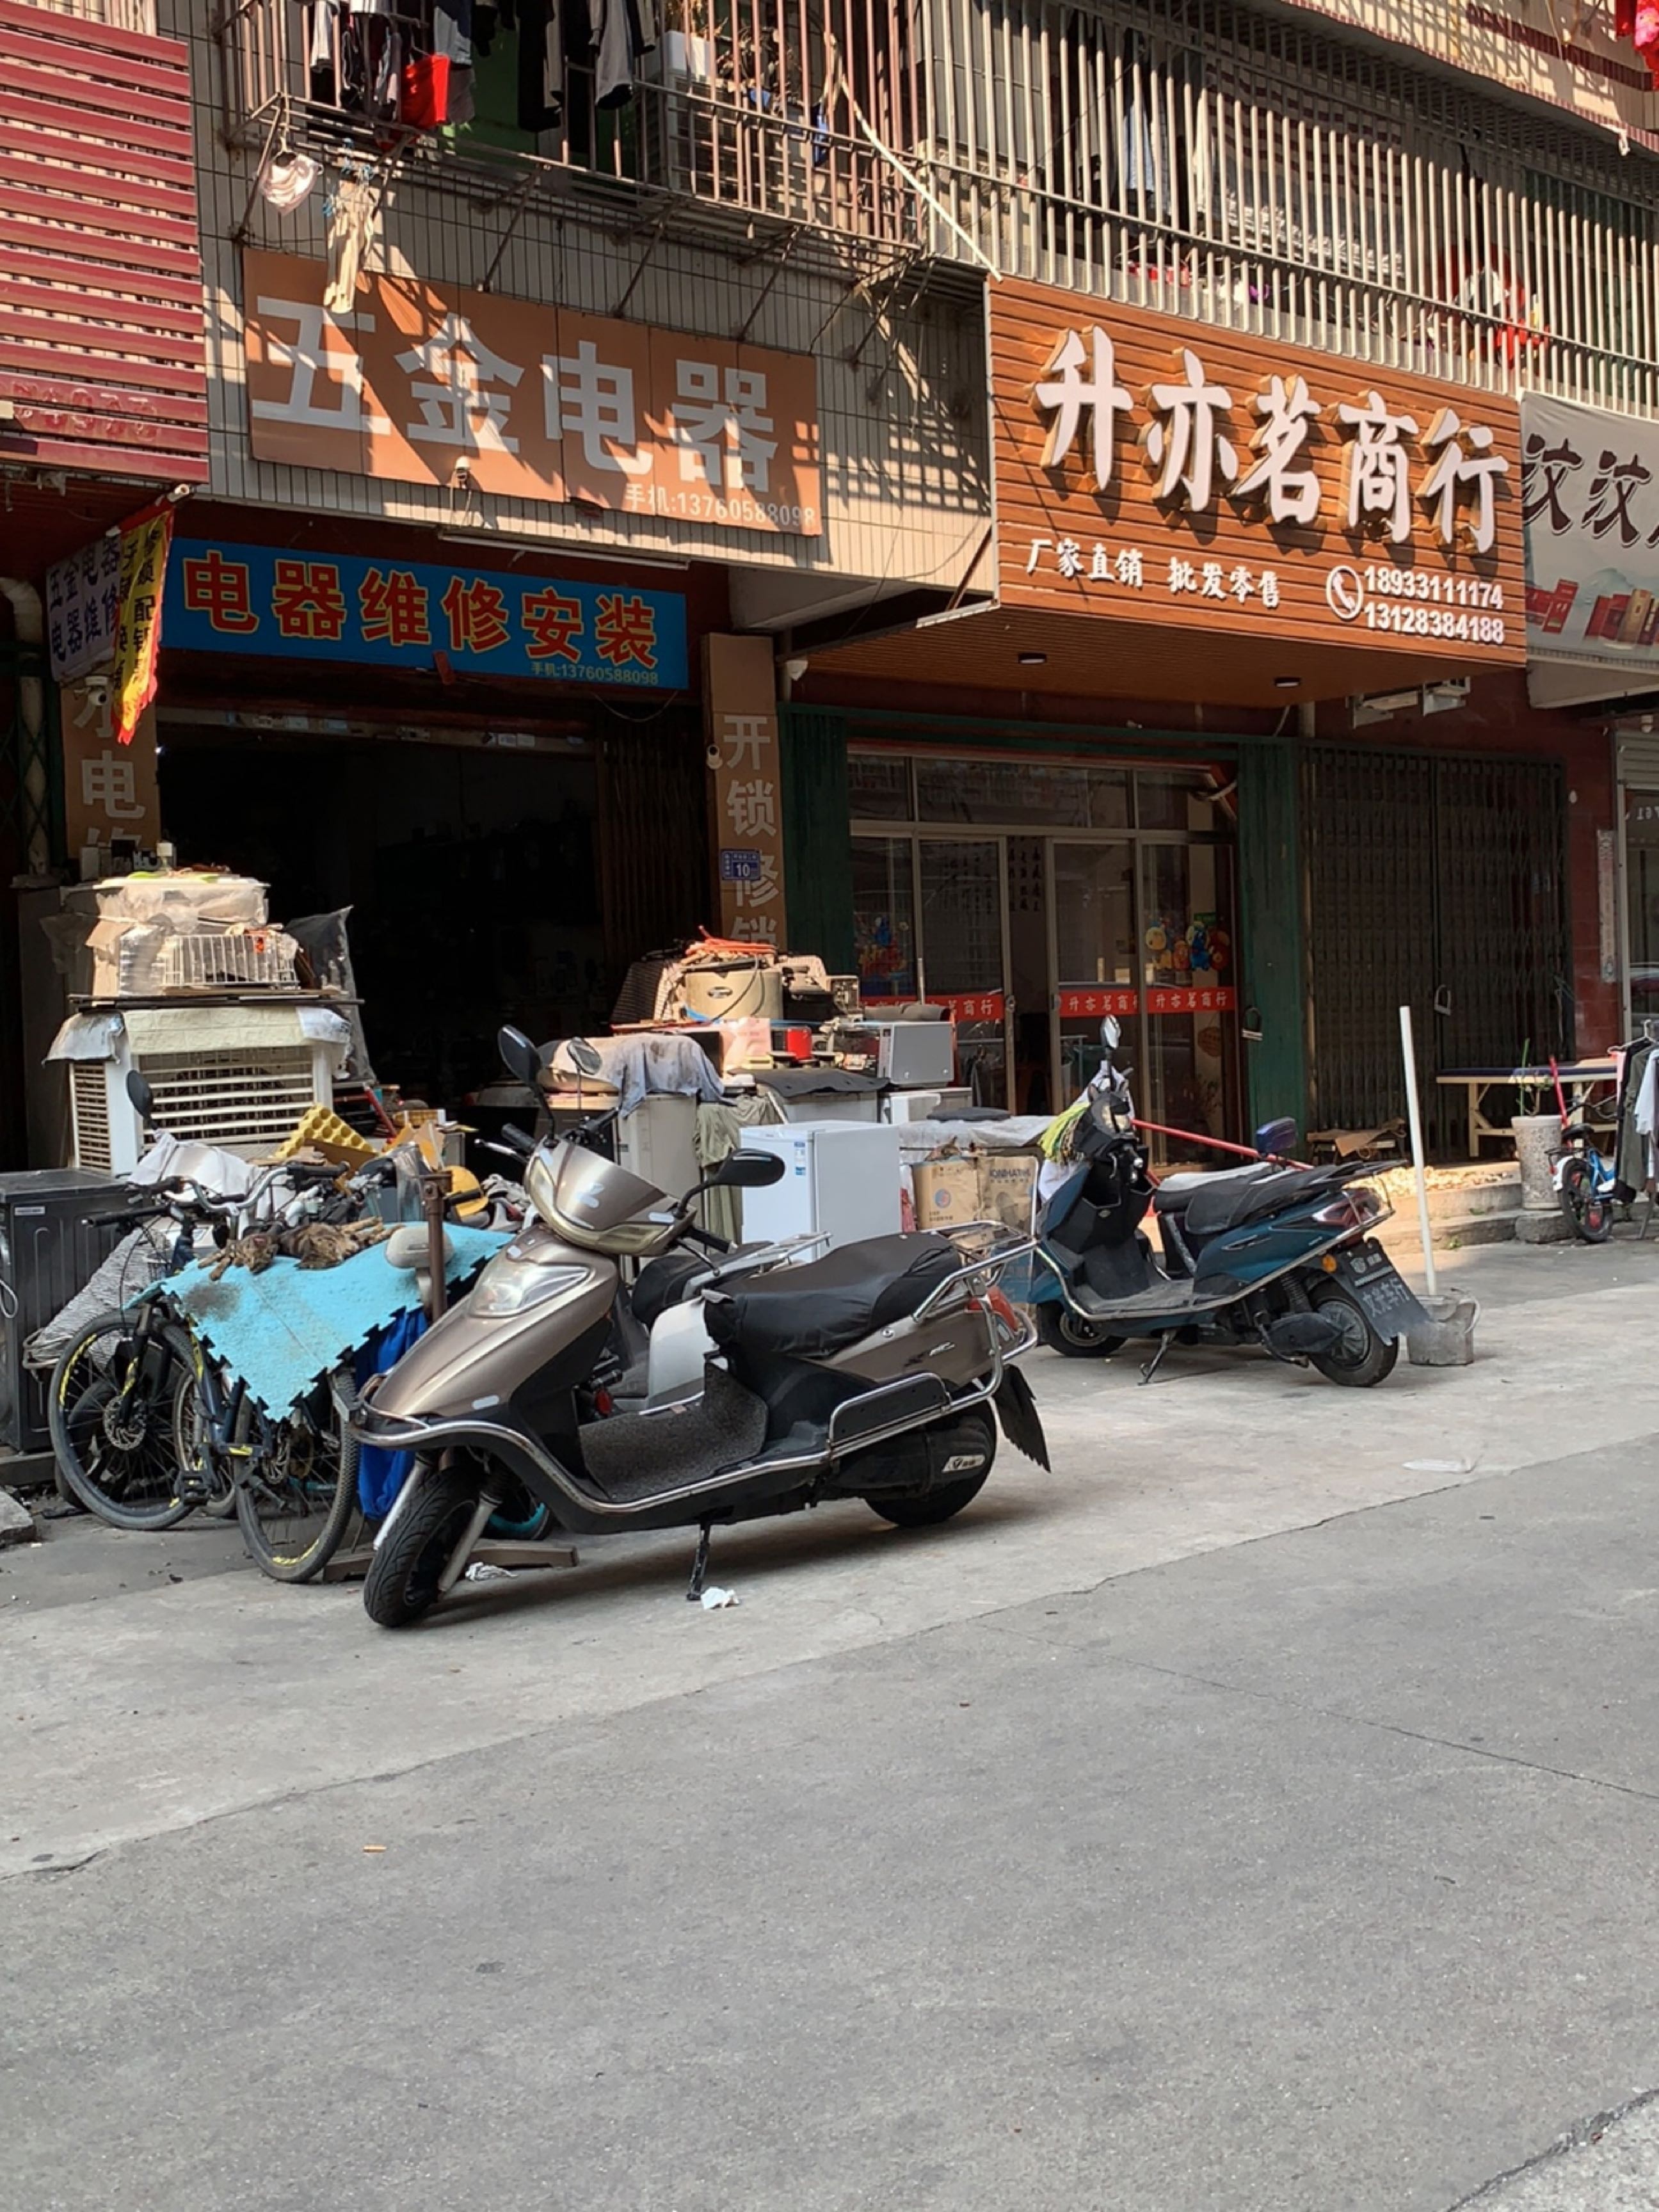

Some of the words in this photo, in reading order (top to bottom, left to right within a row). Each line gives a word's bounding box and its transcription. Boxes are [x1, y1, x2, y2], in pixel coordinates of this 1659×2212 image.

[252, 294, 777, 492] 五金电器
[1030, 323, 1509, 555] 升亦茗商行
[625, 483, 815, 526] 手机:13760588098
[1522, 433, 1659, 548] 汶汶
[1026, 537, 1144, 588] 厂家直销
[1167, 556, 1279, 608] 批发零售
[1364, 565, 1503, 609] 18933111174
[182, 549, 660, 669] 电器维修安装
[1364, 602, 1504, 645] 13128384188
[737, 863, 751, 876] 10
